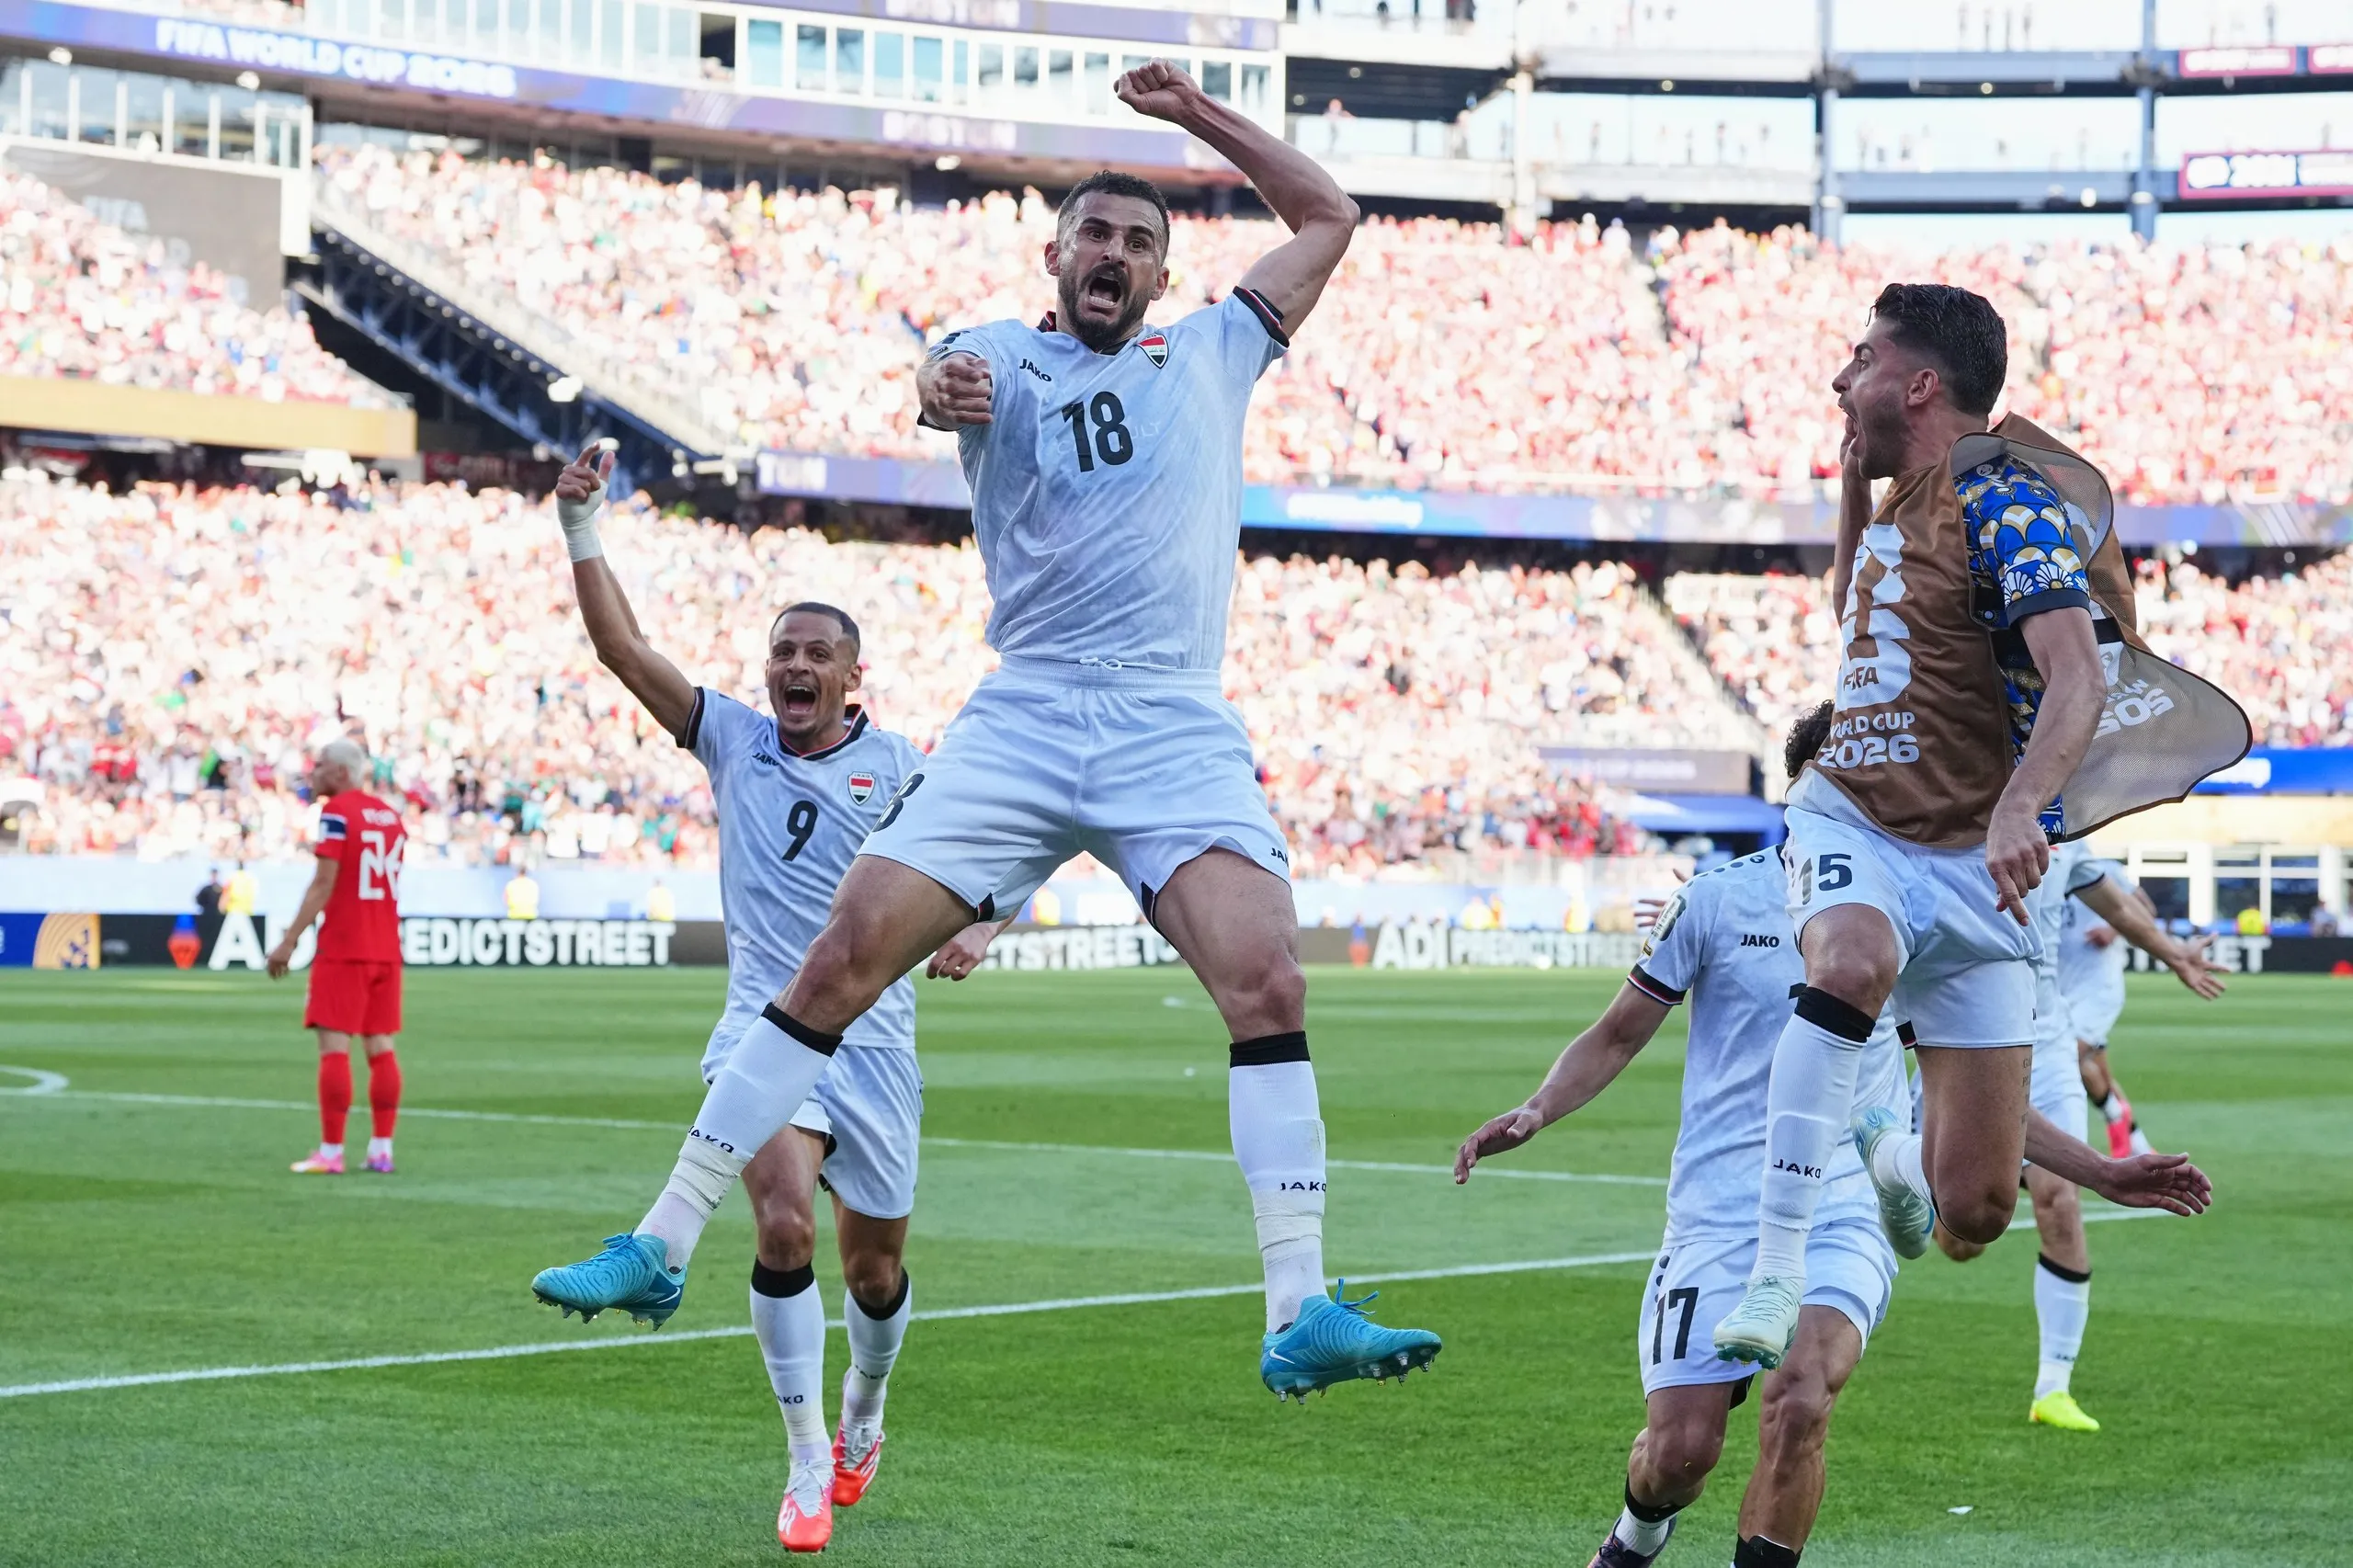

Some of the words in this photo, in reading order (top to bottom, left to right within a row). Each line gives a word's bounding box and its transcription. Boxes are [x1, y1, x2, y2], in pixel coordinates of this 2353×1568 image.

[155, 19, 228, 59] FIFA
[227, 28, 342, 74] WORLD
[343, 45, 406, 83] CUP
[1018, 358, 1051, 381] JAKO
[1062, 391, 1134, 472] 18
[1843, 666, 1879, 691] FIFA
[1817, 733, 1920, 769] 2026
[1830, 715, 1870, 742] ORD
[1872, 711, 1915, 732] CUP
[781, 800, 819, 862] 9
[1798, 853, 1853, 906] 15
[208, 910, 325, 971] AD
[397, 918, 676, 966] EDICTSTREET
[1373, 918, 1448, 971] ADI
[1450, 929, 1643, 969] PREDICTSTREE
[1740, 934, 1780, 948] JAKO
[1773, 1158, 1822, 1178] JAKO
[1653, 1287, 1699, 1366] 17
